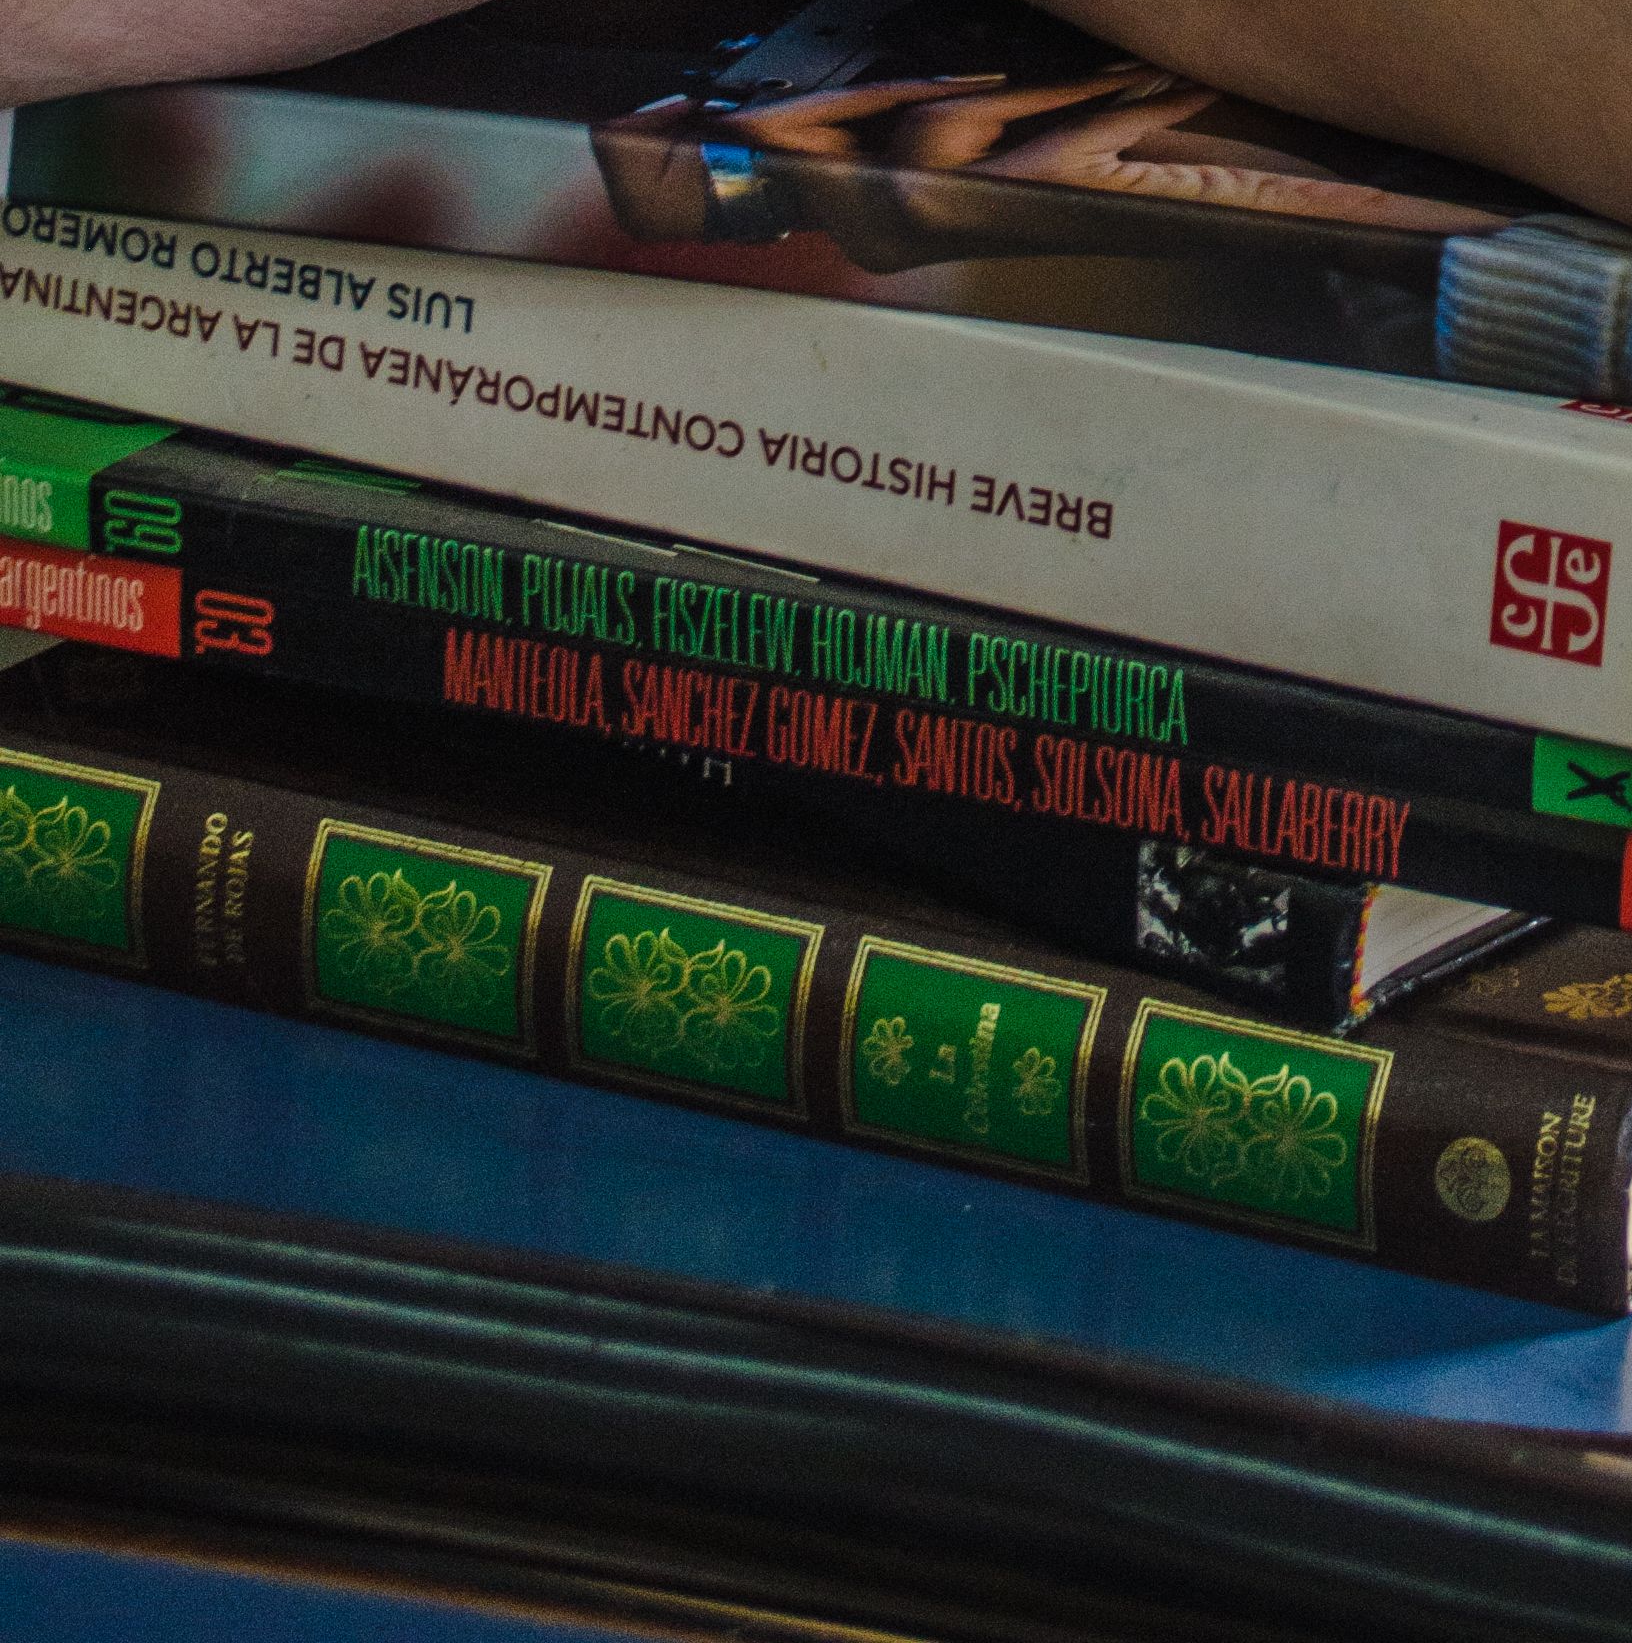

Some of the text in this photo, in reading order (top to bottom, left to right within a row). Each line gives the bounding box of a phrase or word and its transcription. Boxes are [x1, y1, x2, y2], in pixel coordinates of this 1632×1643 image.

[2, 204, 476, 334] LUIS ALBERTO ROMERO
[0, 263, 1115, 540] BREVE HISTORIA CONTEMPORÁNEA DE LA ARGENTINA
[193, 587, 277, 657] 03.
[967, 631, 1189, 746] PSCHEPIURCA
[442, 626, 612, 739] MANTEOLA,
[622, 658, 760, 759] SANCHEZ
[767, 686, 884, 787] GOMEZ,
[892, 708, 1023, 812] SANTOS,
[1031, 733, 1191, 841] SOLSONA,
[1201, 765, 1412, 878] SALLABERRY
[224, 828, 255, 919] ROJAS
